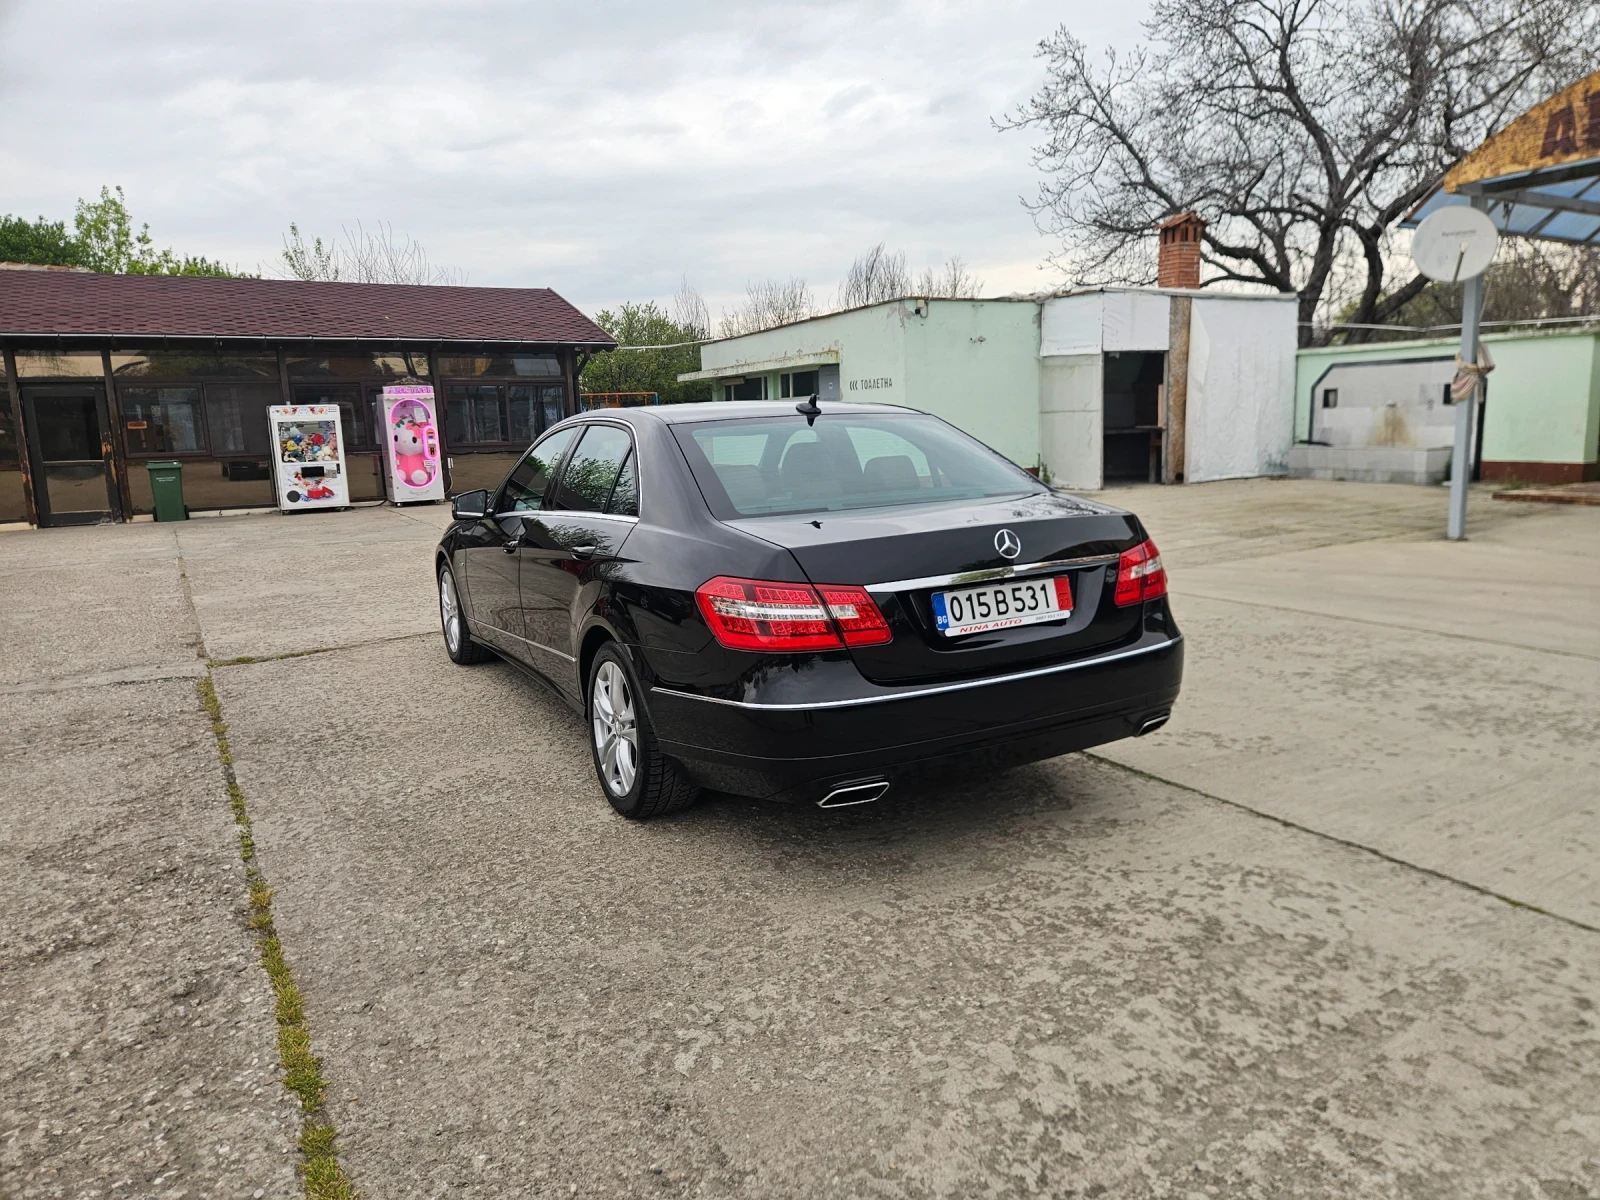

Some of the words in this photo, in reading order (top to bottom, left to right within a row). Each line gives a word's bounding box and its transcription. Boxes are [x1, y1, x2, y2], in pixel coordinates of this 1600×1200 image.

[861, 377, 893, 390] ТОАЛЕТНА
[937, 615, 948, 624] BG
[959, 624, 989, 633] NINA
[992, 618, 1023, 628] AUTO
